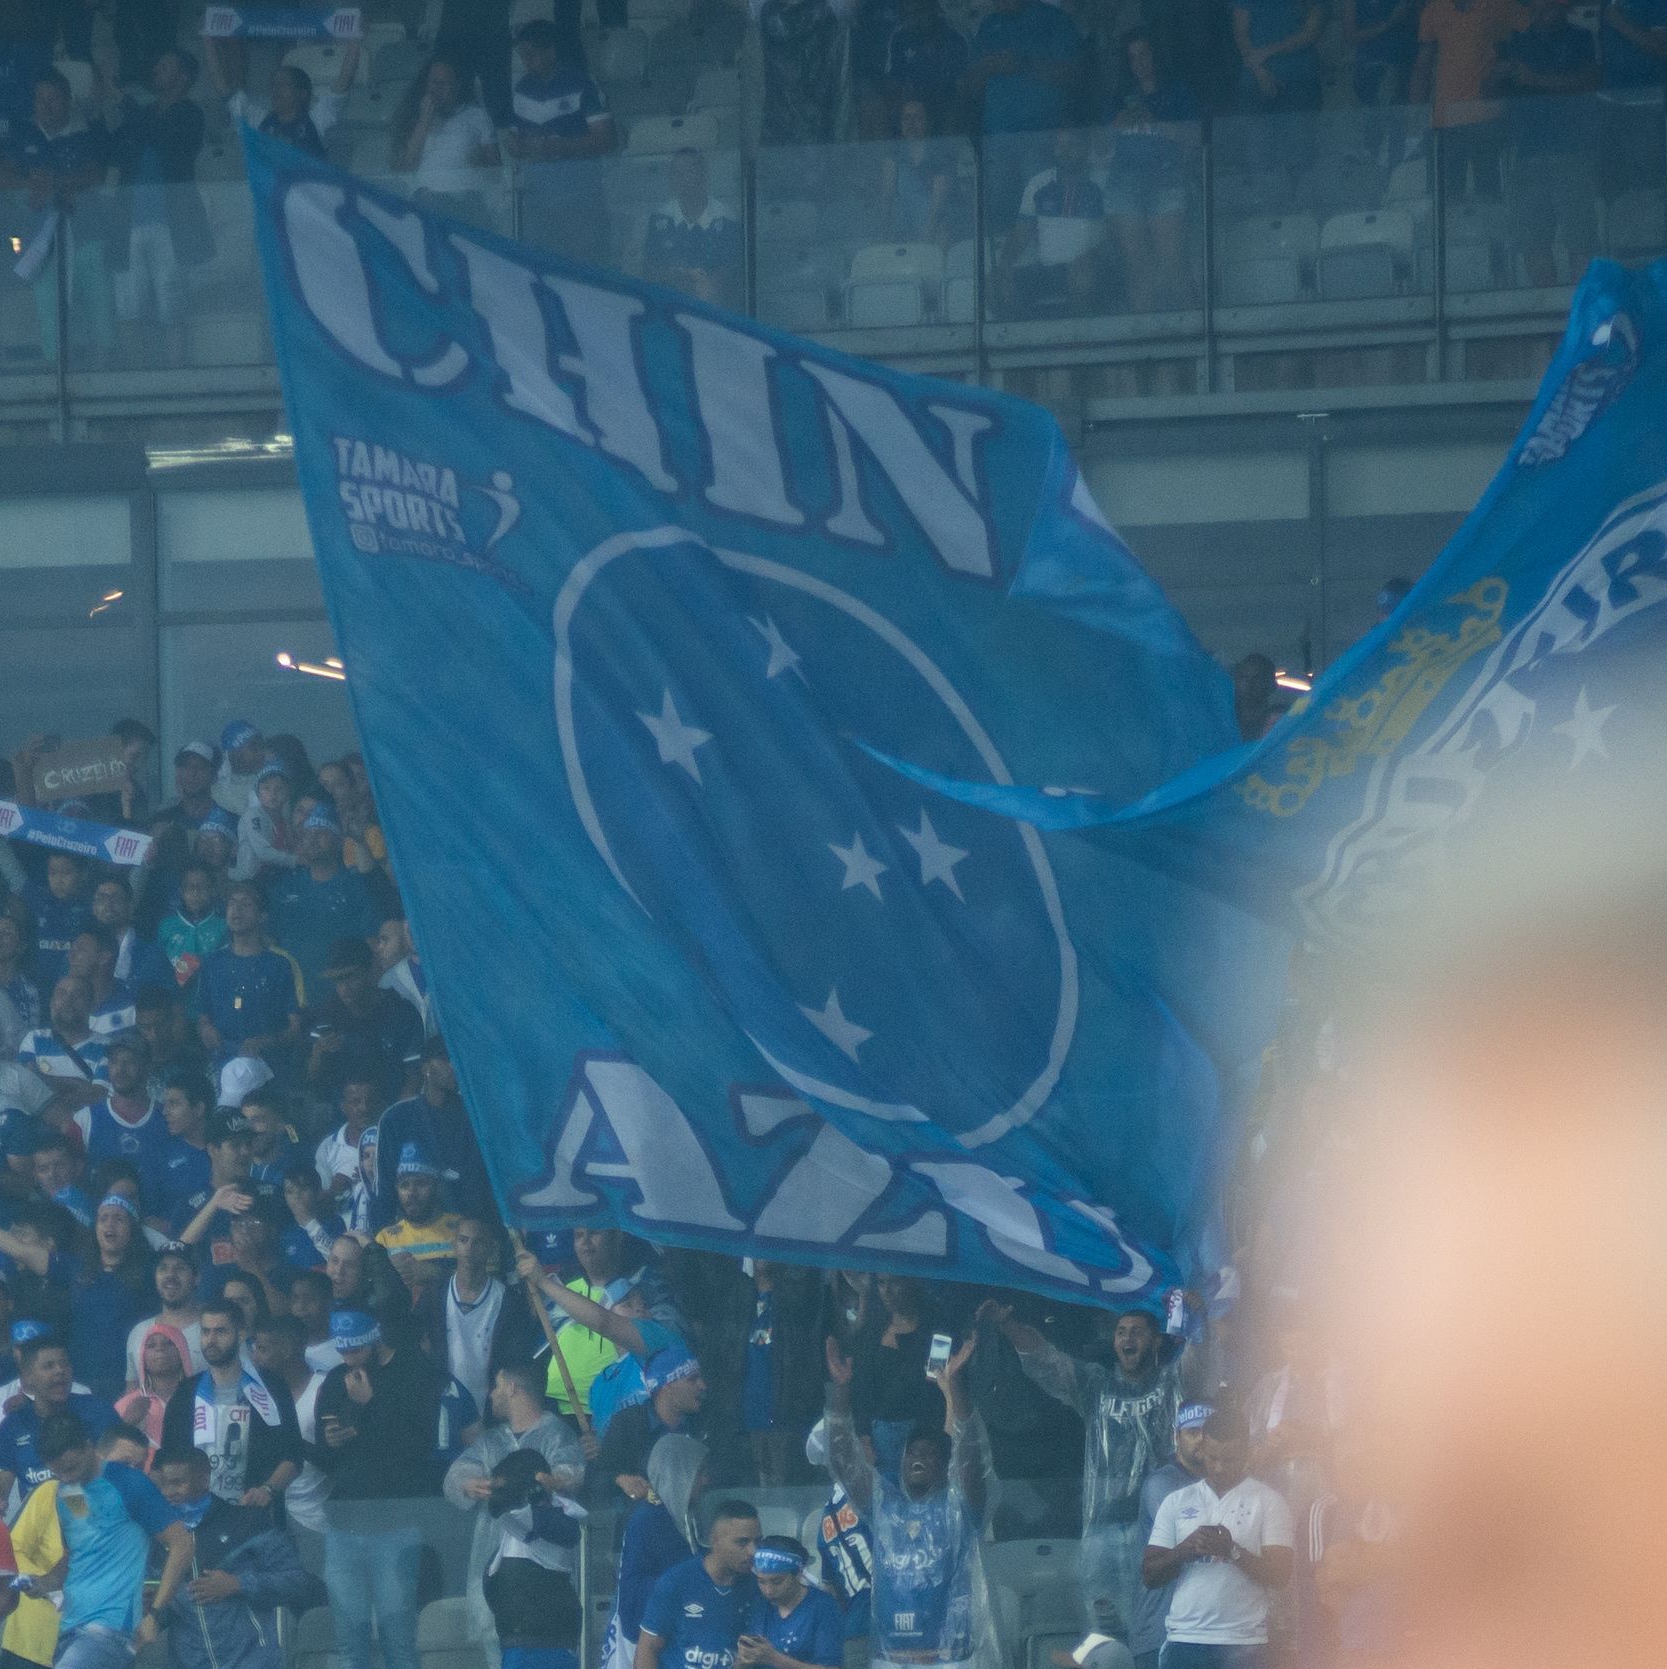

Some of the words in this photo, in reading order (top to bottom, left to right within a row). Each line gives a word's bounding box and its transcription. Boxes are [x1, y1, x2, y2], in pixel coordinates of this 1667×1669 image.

[332, 437, 460, 509] TAMARA
[337, 478, 467, 546] SPORTS
[110, 834, 141, 863] FIAT
